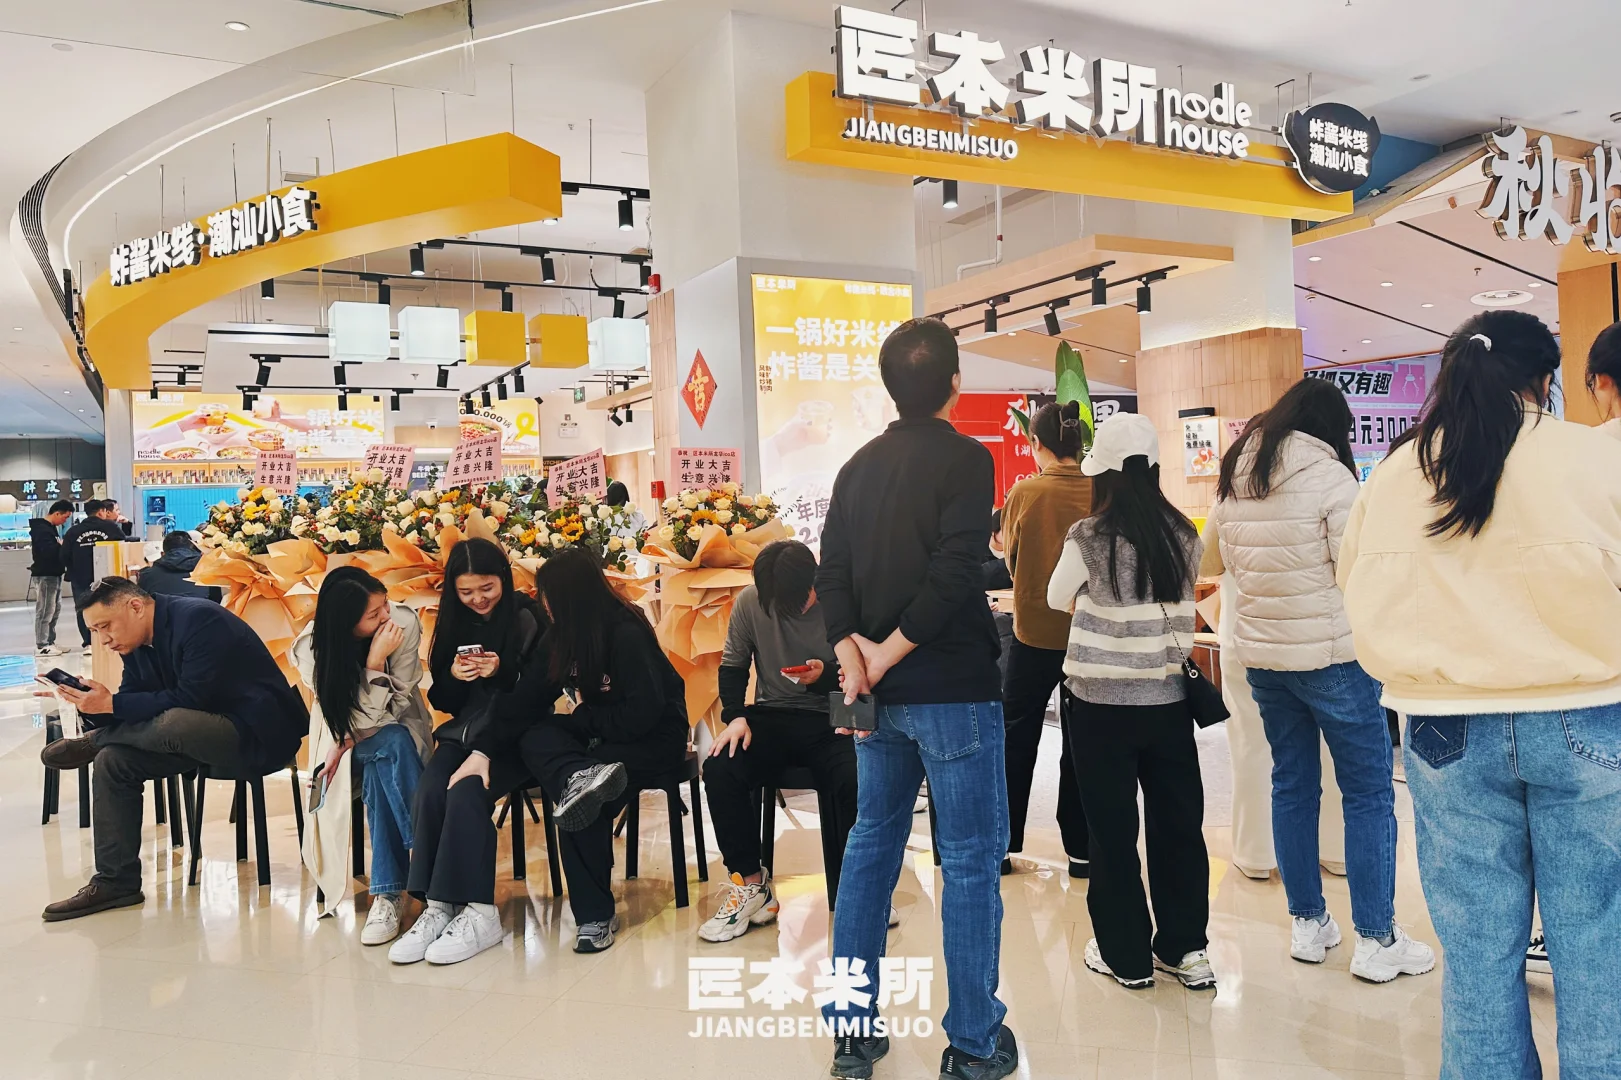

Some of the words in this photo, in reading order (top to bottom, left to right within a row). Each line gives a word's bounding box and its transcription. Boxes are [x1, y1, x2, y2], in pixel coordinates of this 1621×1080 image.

[836, 5, 1157, 144] 匠本米所
[845, 117, 1020, 160] JIANGBENMISUO
[1164, 115, 1250, 159] house
[1308, 117, 1369, 153] 炸酱米线
[1308, 142, 1369, 178] 潮汕小食
[368, 452, 407, 465] 开业大吉
[455, 446, 493, 463] 开业大吉
[261, 461, 291, 472] 开业大吉
[452, 460, 493, 476] 生意兴隆
[555, 462, 598, 483] 开业大吉
[681, 459, 731, 471] 开业大吉
[260, 474, 291, 485] 生意兴隆
[681, 472, 731, 484] 生意兴隆
